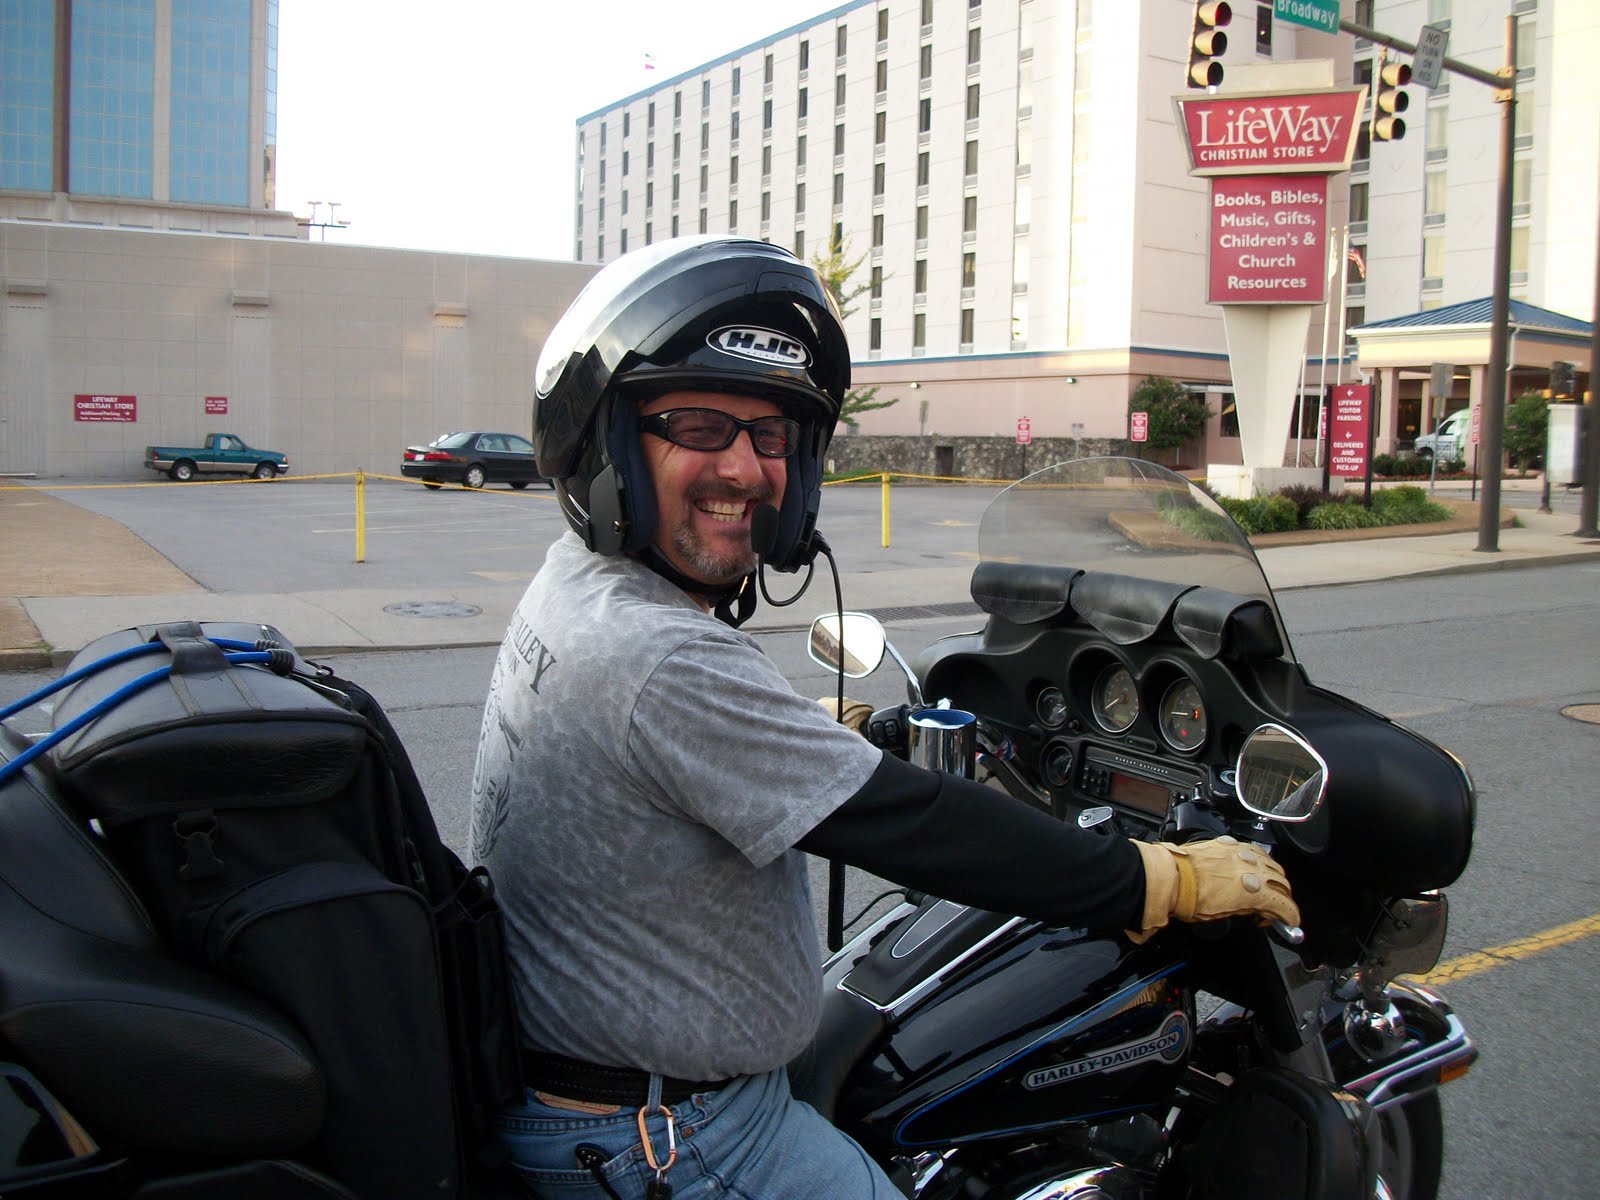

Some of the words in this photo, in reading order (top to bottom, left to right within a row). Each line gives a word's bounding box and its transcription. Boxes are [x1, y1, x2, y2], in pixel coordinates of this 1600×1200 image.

[1277, 0, 1336, 29] Broadway
[1426, 33, 1440, 46] NO
[1422, 45, 1439, 57] TURN
[1422, 59, 1433, 69] ON
[1417, 70, 1432, 82] RED
[1197, 105, 1343, 153] LifeWay
[1200, 148, 1267, 161] CHRISTIAN
[1273, 146, 1314, 158] STORE
[1214, 192, 1266, 207] Books,
[1271, 190, 1324, 205] Bibles,
[1221, 213, 1269, 228] Music,
[1274, 211, 1316, 226] Gifts,
[1219, 232, 1298, 247] Children's
[1303, 232, 1316, 246] &
[1238, 254, 1296, 269] Church
[1227, 275, 1307, 290] Resources
[726, 331, 801, 359] HJC
[1033, 1033, 1177, 1086] HARLEY-DAVIDSON
